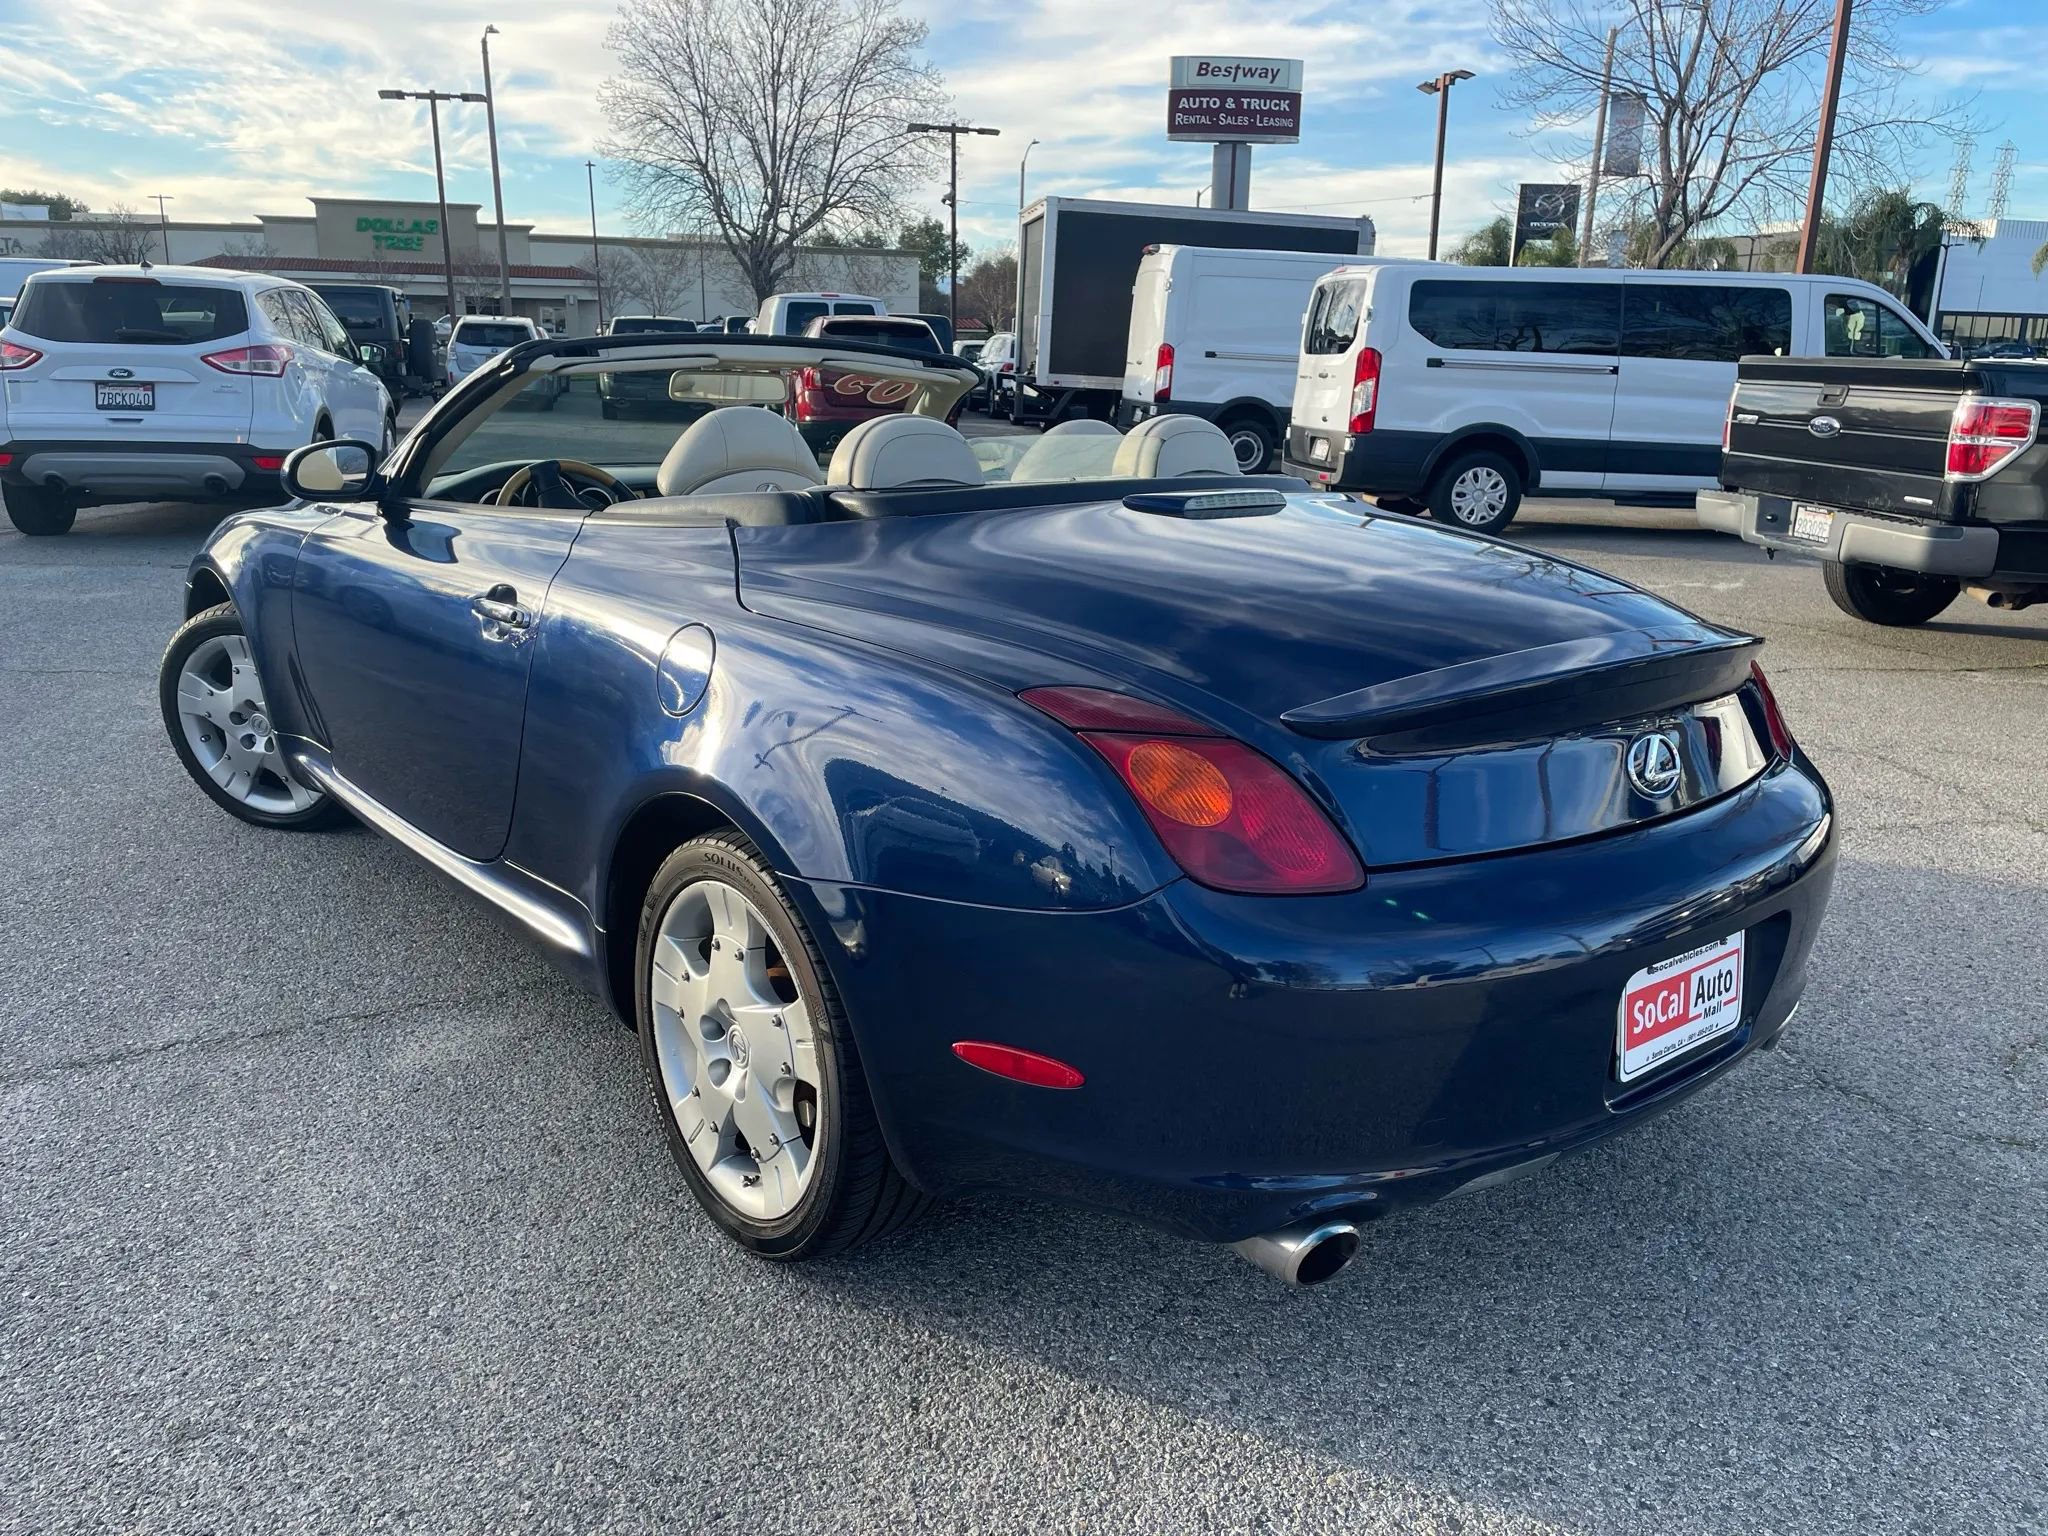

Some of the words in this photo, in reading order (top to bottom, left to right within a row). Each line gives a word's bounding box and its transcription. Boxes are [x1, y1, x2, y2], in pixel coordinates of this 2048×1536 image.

[1196, 62, 1280, 84] Bestway
[1178, 97, 1220, 109] AUTO
[1225, 97, 1236, 109] &
[1240, 98, 1290, 112] TRUCK
[1175, 112, 1212, 126] RENTAL
[1218, 112, 1249, 126] SALES
[1256, 114, 1294, 128] LEASING
[356, 217, 439, 235] DOLLAR
[372, 234, 424, 251] TREE
[100, 392, 150, 405] 7BCK040
[1633, 981, 1685, 1034] SoCal
[1694, 967, 1733, 1008] Auto
[1703, 1001, 1722, 1019] Mall
